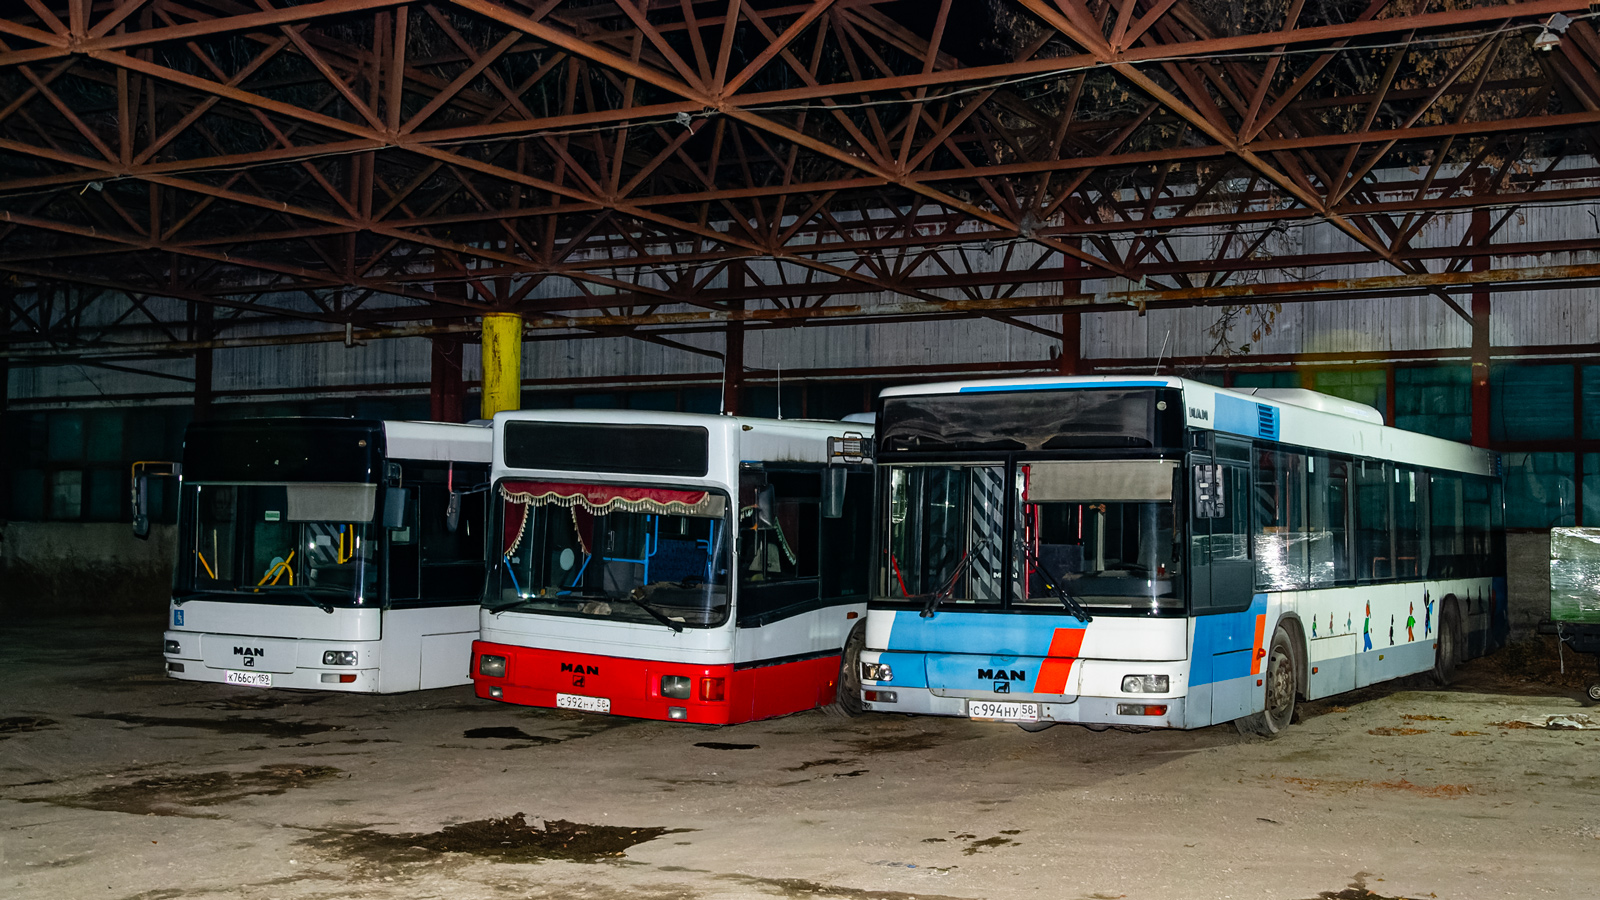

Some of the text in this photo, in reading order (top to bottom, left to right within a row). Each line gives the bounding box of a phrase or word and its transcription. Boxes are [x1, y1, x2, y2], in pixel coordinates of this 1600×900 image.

[1188, 406, 1209, 421] MAN
[233, 646, 264, 657] MAN
[561, 662, 599, 676] MAN
[977, 668, 1025, 681] MAN
[1022, 704, 1034, 715] 58
